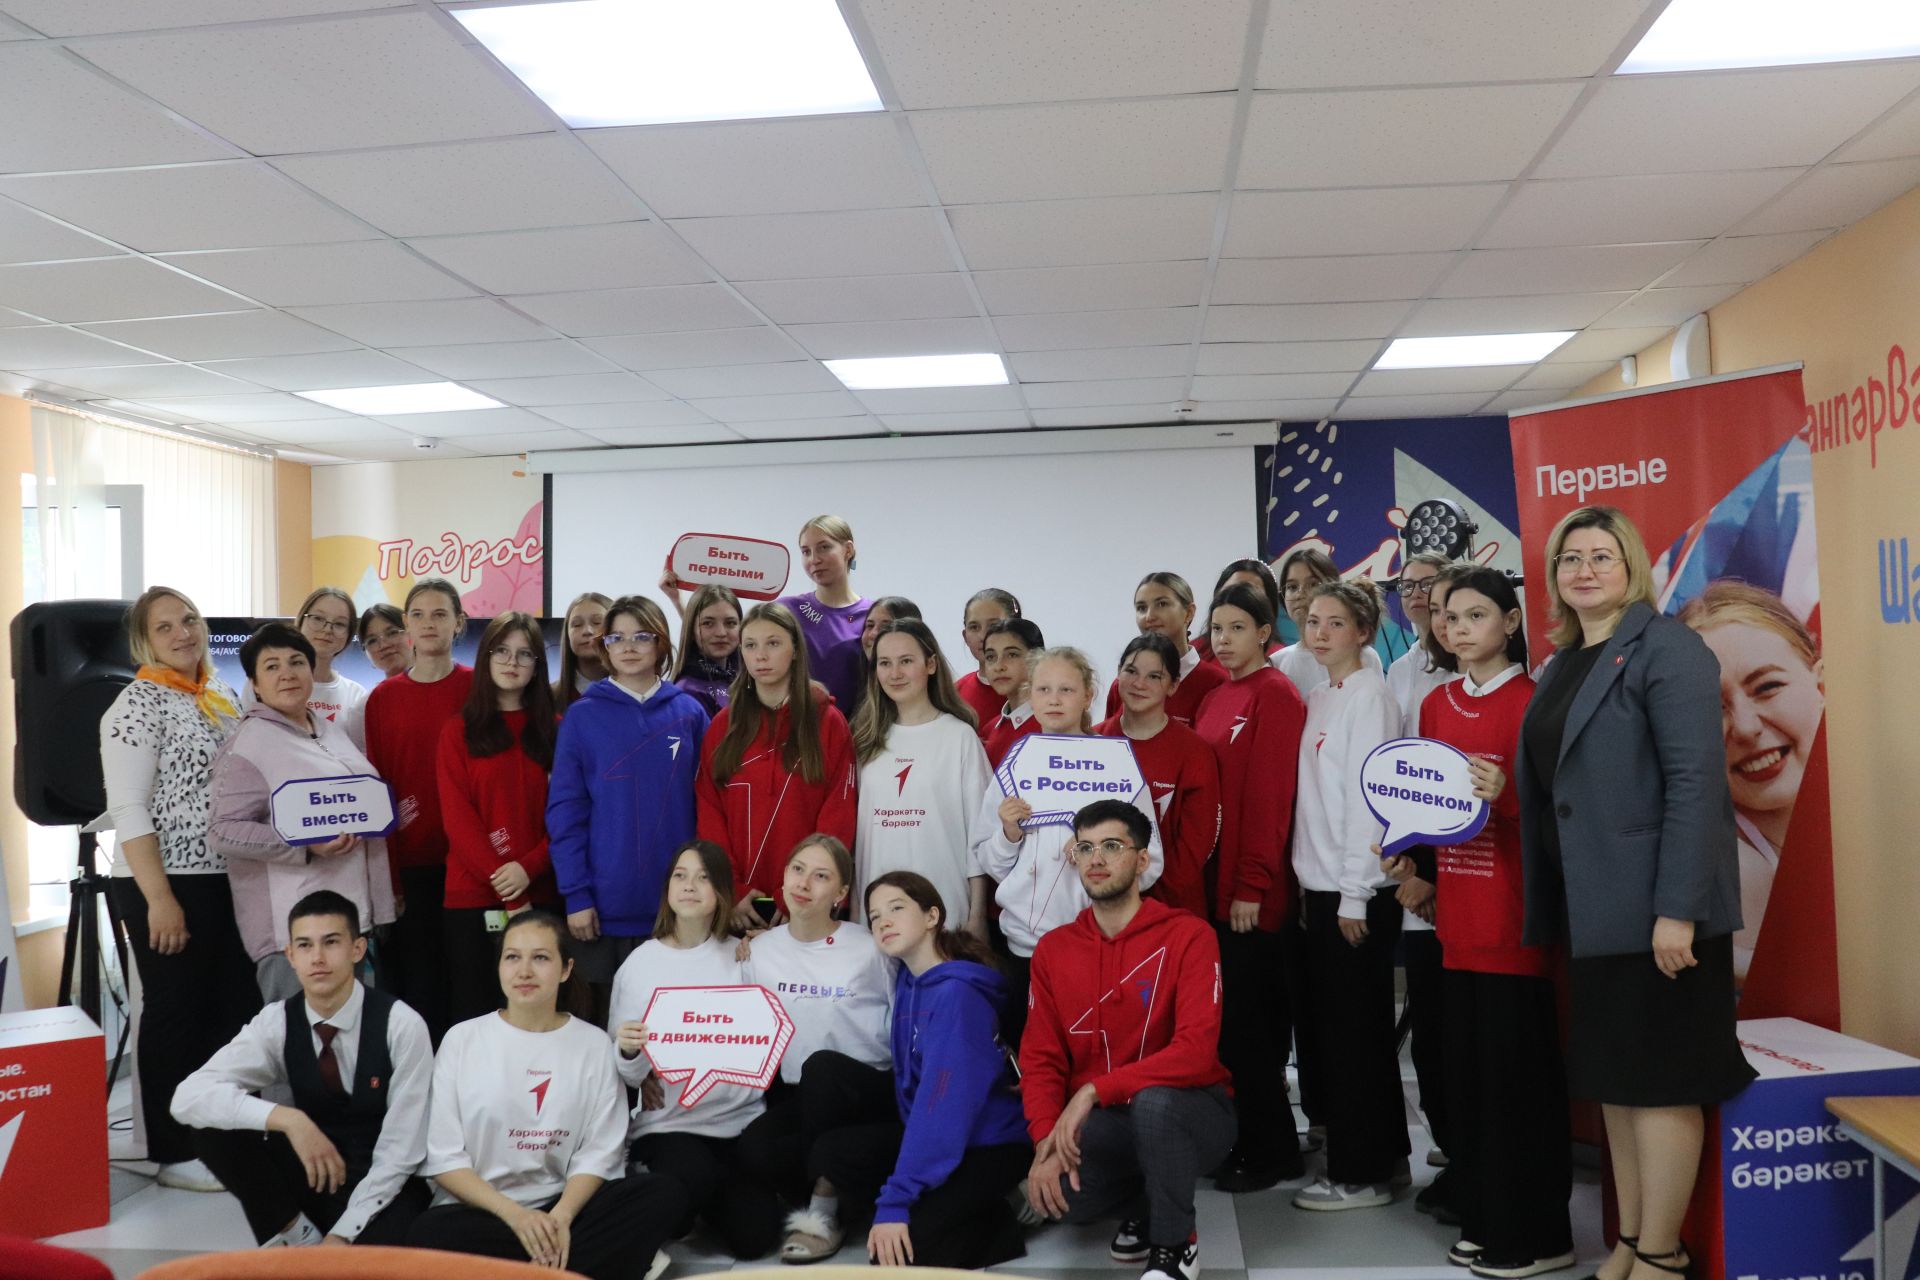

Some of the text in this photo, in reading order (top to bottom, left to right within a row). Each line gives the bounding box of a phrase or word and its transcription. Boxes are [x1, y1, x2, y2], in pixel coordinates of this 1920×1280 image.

[1536, 457, 1667, 502] Первые
[378, 532, 544, 583] Подрос
[708, 546, 750, 561] Быть
[688, 563, 764, 580] первыми
[1048, 755, 1105, 771] Быть
[1396, 759, 1445, 782] Быть
[1019, 776, 1132, 793] с Россией
[309, 792, 357, 805] Быть
[1367, 782, 1473, 813] человеком
[302, 812, 369, 827] вместе
[778, 982, 844, 997] ПЕРВЫЕ
[682, 1011, 734, 1024] Быть
[648, 1032, 770, 1045] в движении
[1731, 1158, 1868, 1190] бәрәкәт
